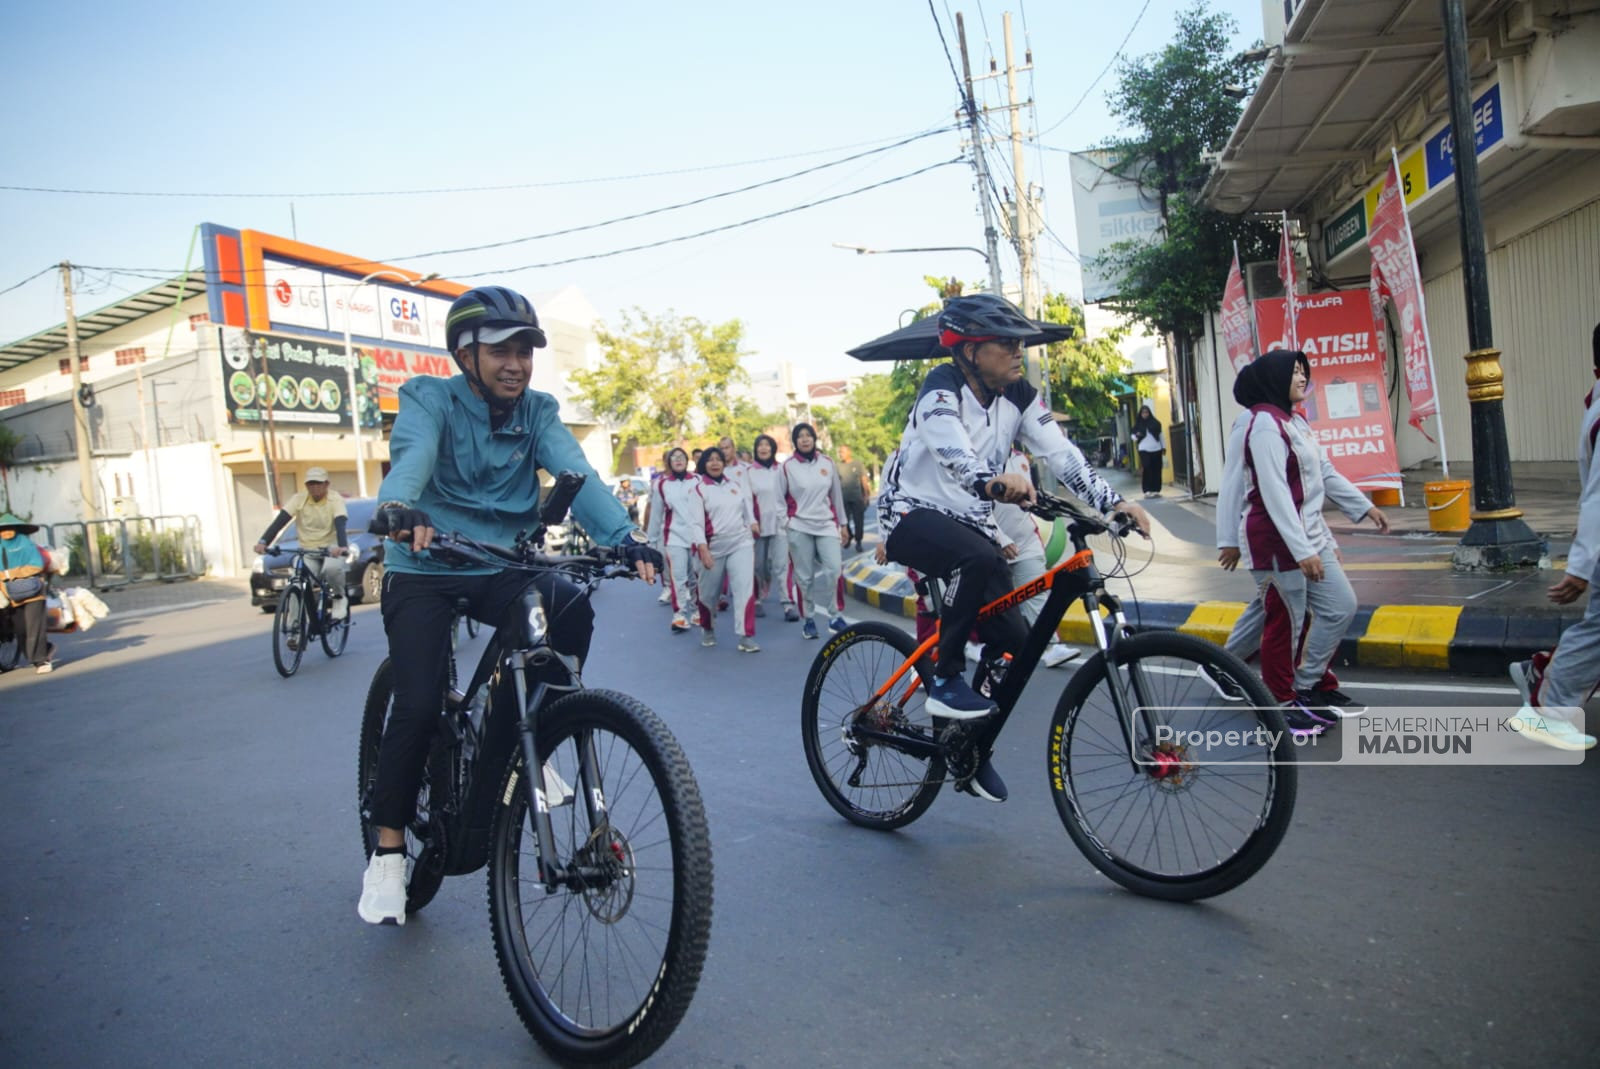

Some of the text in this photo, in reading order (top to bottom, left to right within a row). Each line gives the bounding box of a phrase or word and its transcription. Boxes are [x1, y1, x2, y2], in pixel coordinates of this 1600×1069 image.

[298, 288, 320, 308] LG
[390, 297, 420, 322] GEA
[1267, 331, 1370, 356] GATIS!!
[411, 353, 453, 377] JAYA
[1312, 424, 1385, 443] ESIALIS
[1322, 439, 1386, 458] TERAI
[1052, 724, 1064, 791] MAXXIS
